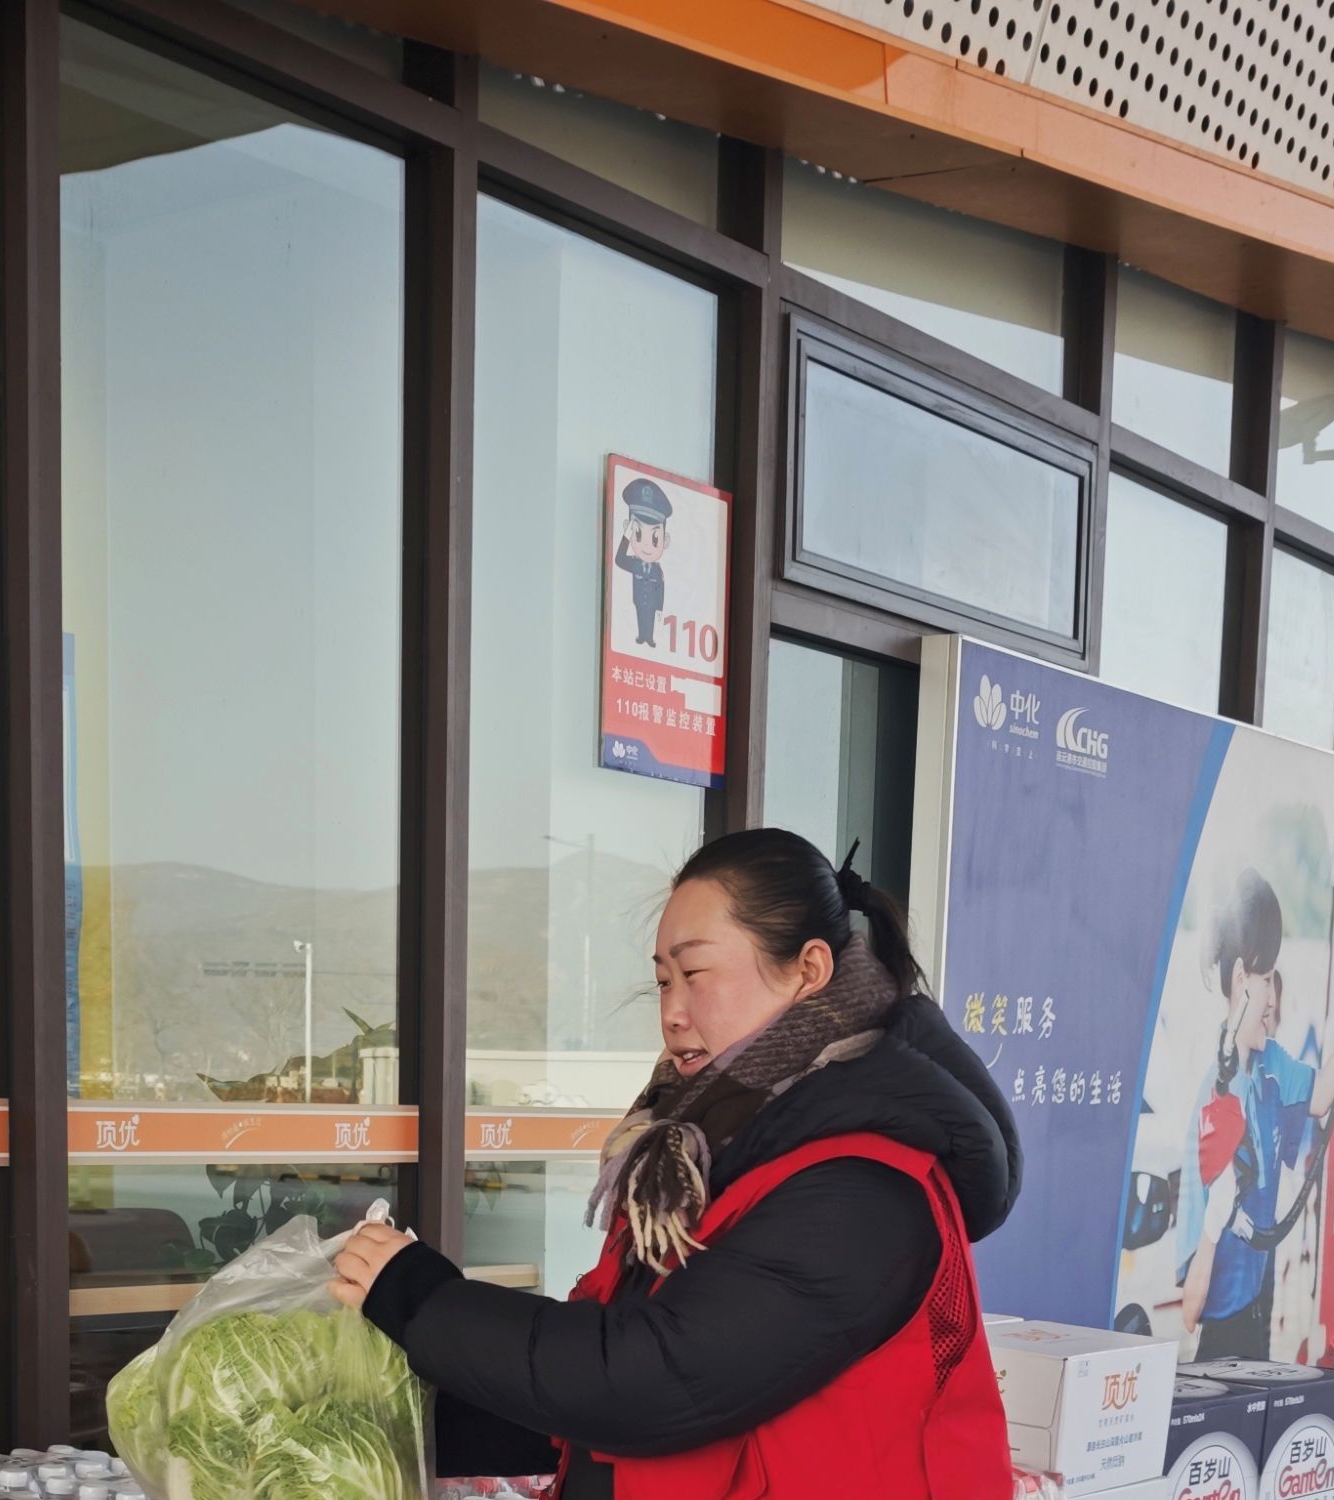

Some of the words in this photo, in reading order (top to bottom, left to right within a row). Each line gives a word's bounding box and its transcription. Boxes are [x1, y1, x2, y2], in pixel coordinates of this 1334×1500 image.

[663, 614, 718, 664] 110
[612, 665, 667, 694] 本站已设置
[616, 698, 716, 736] 110报警监控装置
[1010, 689, 1041, 725] 中化
[963, 992, 1056, 1040] 微笑服务
[1011, 1065, 1122, 1106] 点亮您的生活
[96, 1115, 140, 1151] 顶优
[335, 1117, 371, 1150] 顶优
[480, 1119, 512, 1149] 顶优
[1102, 1366, 1140, 1411] 顶优
[1289, 1436, 1328, 1465] 百岁山
[1188, 1456, 1231, 1486] 百岁山
